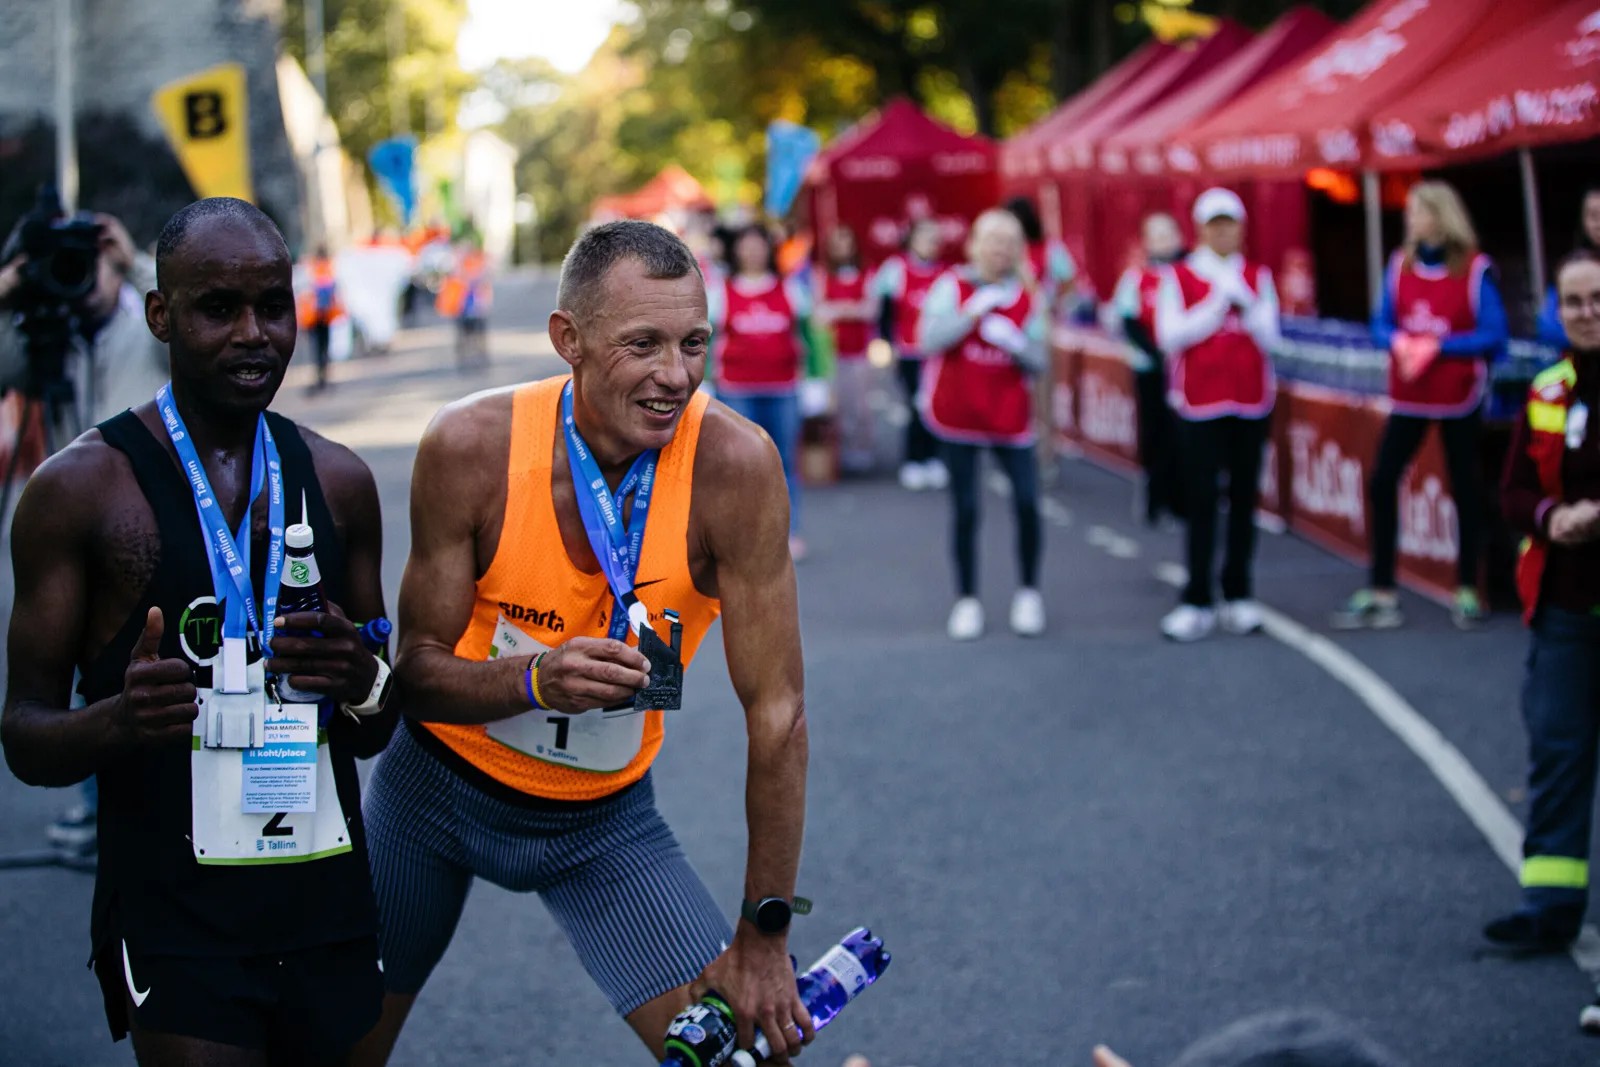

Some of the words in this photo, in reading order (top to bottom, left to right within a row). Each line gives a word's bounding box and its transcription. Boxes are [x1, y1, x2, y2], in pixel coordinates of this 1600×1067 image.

[184, 91, 227, 140] B
[163, 405, 179, 432] Tallinn
[188, 460, 207, 498] Tallinn
[270, 472, 281, 505] Tallinn
[638, 463, 655, 497] Tallinn
[597, 489, 617, 526] Tallinn
[216, 528, 237, 566] Tallinn
[270, 539, 282, 574] Tallinn
[498, 601, 565, 632] sparta
[546, 716, 570, 750] 1
[257, 748, 307, 759] koht/place
[547, 748, 579, 762] Tallinn
[262, 812, 293, 836] 2
[267, 840, 297, 851] Tallinn
